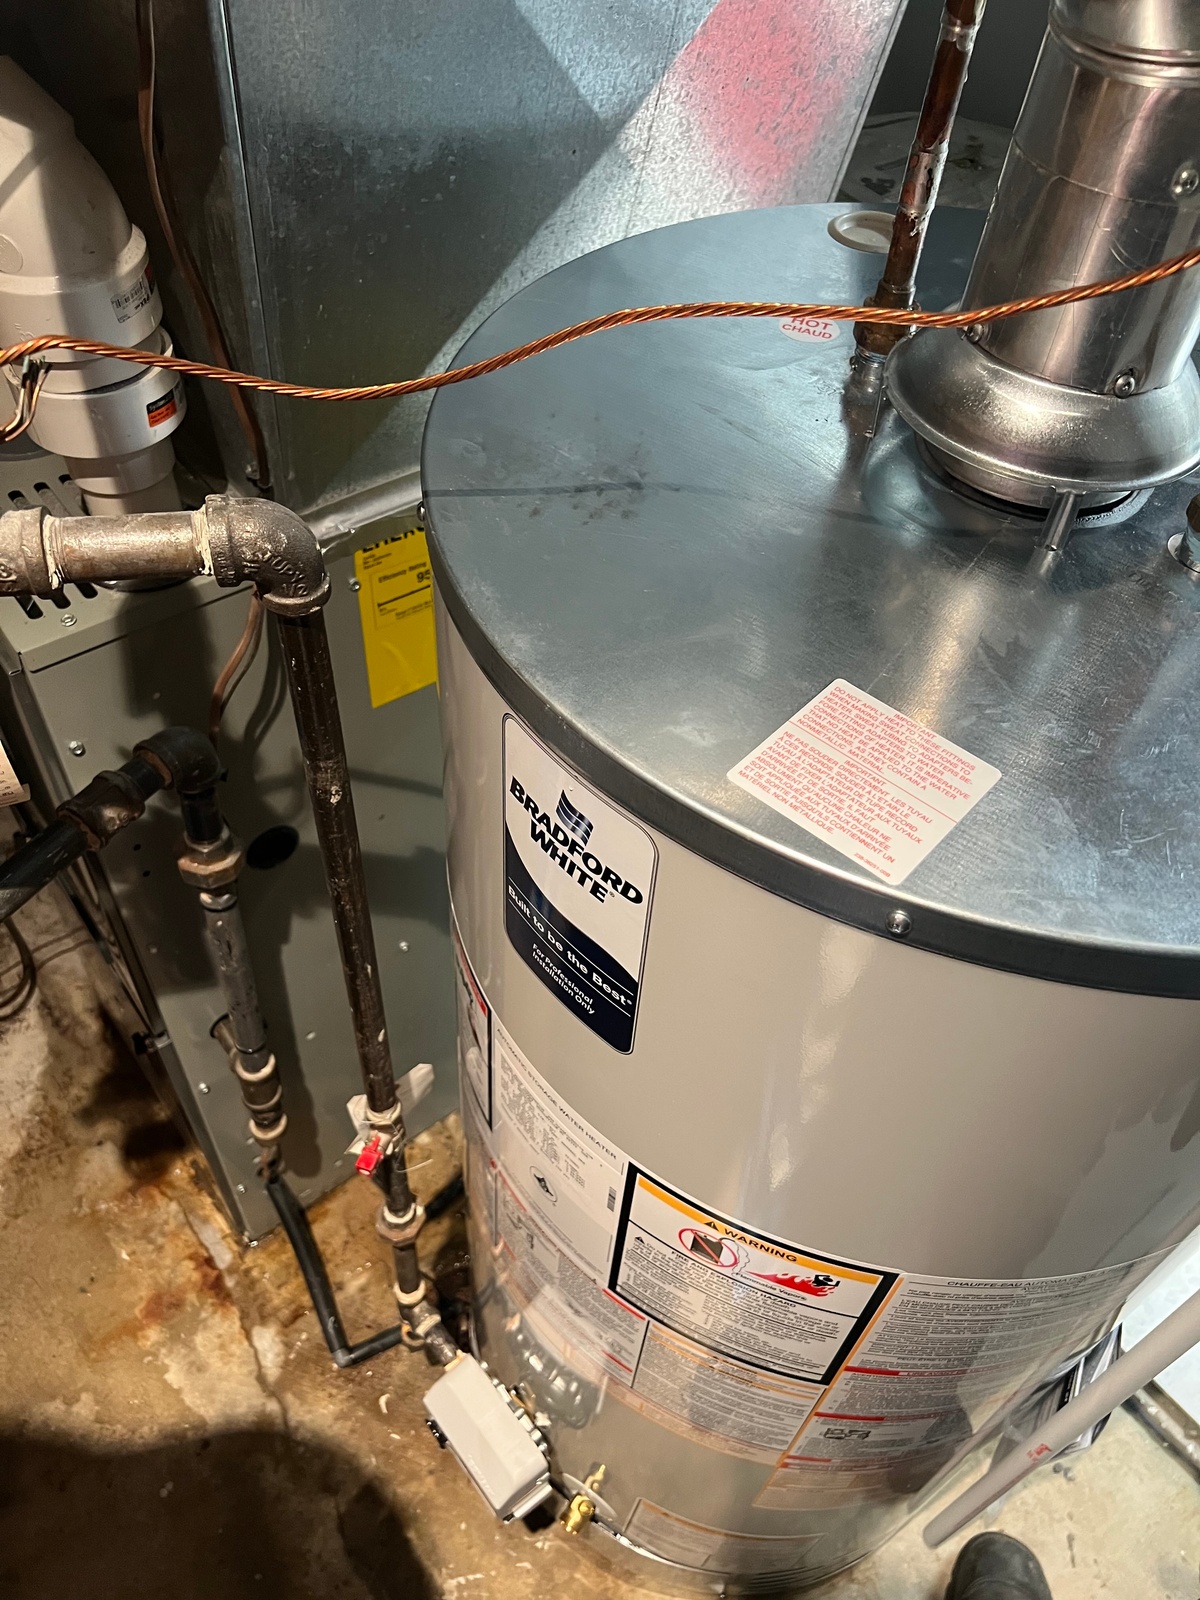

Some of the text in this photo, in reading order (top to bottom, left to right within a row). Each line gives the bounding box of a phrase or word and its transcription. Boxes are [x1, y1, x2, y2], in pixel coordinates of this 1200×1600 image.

[782, 324, 832, 338] CHAUD
[792, 317, 832, 330] HOT
[796, 718, 846, 749] NONMETALLIC
[807, 708, 957, 800] THAT NO HEAT BE APPLIED TO THE WATER
[812, 704, 864, 736] CONNECTIONS
[863, 734, 875, 743] OF
[914, 764, 924, 772] IS
[923, 770, 970, 800] IMPERATIVE
[817, 699, 944, 776] FORE FITTING ADAPTERS TO WATER
[828, 690, 971, 775] WHEN MAKING SWEAT CONNECTIONS TO
[833, 686, 975, 771] DO NOT APPLY HEAT TO THESE FITTINGS
[853, 712, 879, 729] SWEAT
[879, 728, 907, 746] TUBING
[907, 744, 919, 753] TO
[918, 751, 959, 777] ADAPTERS
[958, 774, 974, 785] BE-
[893, 713, 936, 740] IMPORTANT
[749, 759, 767, 772] SOIT
[804, 794, 821, 807] AUX
[820, 804, 851, 825] TUYAUX
[754, 754, 891, 842] ABSOLUMENT QU'AUCUNE CHALEUR NE
[766, 745, 922, 844] AVANT DE FIXER L'ADAPTATEUR AUX TUYAUX
[771, 740, 797, 757] TUYAU
[801, 758, 854, 792] L'ADAPTATEUR
[852, 790, 865, 799] DE
[884, 809, 918, 832] RECORD
[771, 791, 789, 804] NON
[783, 731, 932, 824] NE PAS SOUDER DIRECTEMENT LES TUYAU
[783, 739, 799, 750] CES
[834, 770, 866, 791] SOUDER
[899, 810, 911, 819] LE
[796, 772, 808, 781] ET
[806, 778, 818, 787] DE
[854, 808, 875, 823] FAUT
[843, 759, 886, 787] IMPORTANT
[854, 745, 866, 753] AS
[865, 752, 886, 766] THEY
[885, 764, 920, 786] CONTAIN
[510, 775, 643, 904] BRADFORD
[743, 764, 895, 863] ET DE SORTIE PUISQU'ILS CONTIENNENT UN
[530, 818, 608, 904] WHITE
[508, 885, 626, 1005] Built to be the Best
[532, 944, 594, 1004] For Professional
[532, 951, 595, 1014] Installation Only
[528, 1071, 558, 1107] STORAGE
[558, 1106, 584, 1132] WATER
[585, 1132, 617, 1160] HEATER
[723, 1228, 798, 1262] WARNING
[759, 1293, 796, 1307] HAZARD
